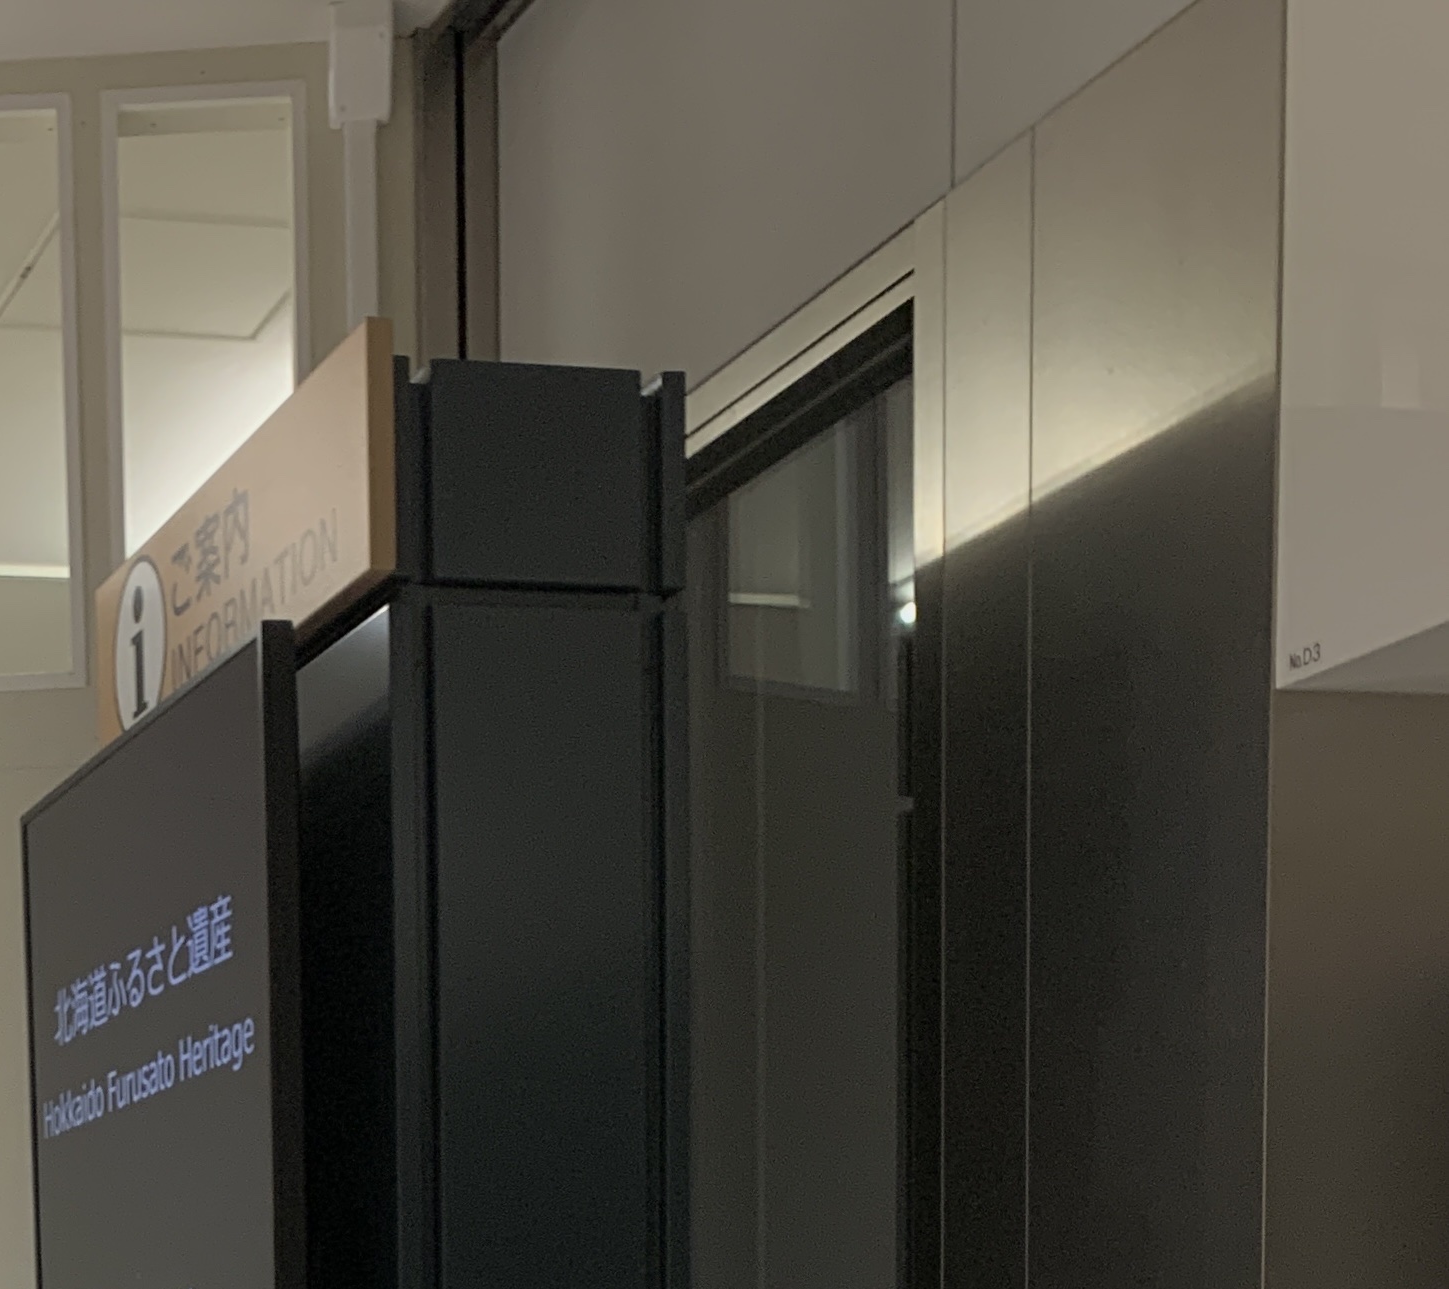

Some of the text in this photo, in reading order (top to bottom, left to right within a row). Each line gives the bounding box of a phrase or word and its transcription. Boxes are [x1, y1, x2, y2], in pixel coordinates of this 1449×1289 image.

[170, 487, 250, 618] ご案内
[171, 507, 339, 692] INFORMATION
[54, 894, 234, 1047] 北海道ふるさと遺産
[43, 1016, 255, 1139] Hokkaido Furusato Heritage
